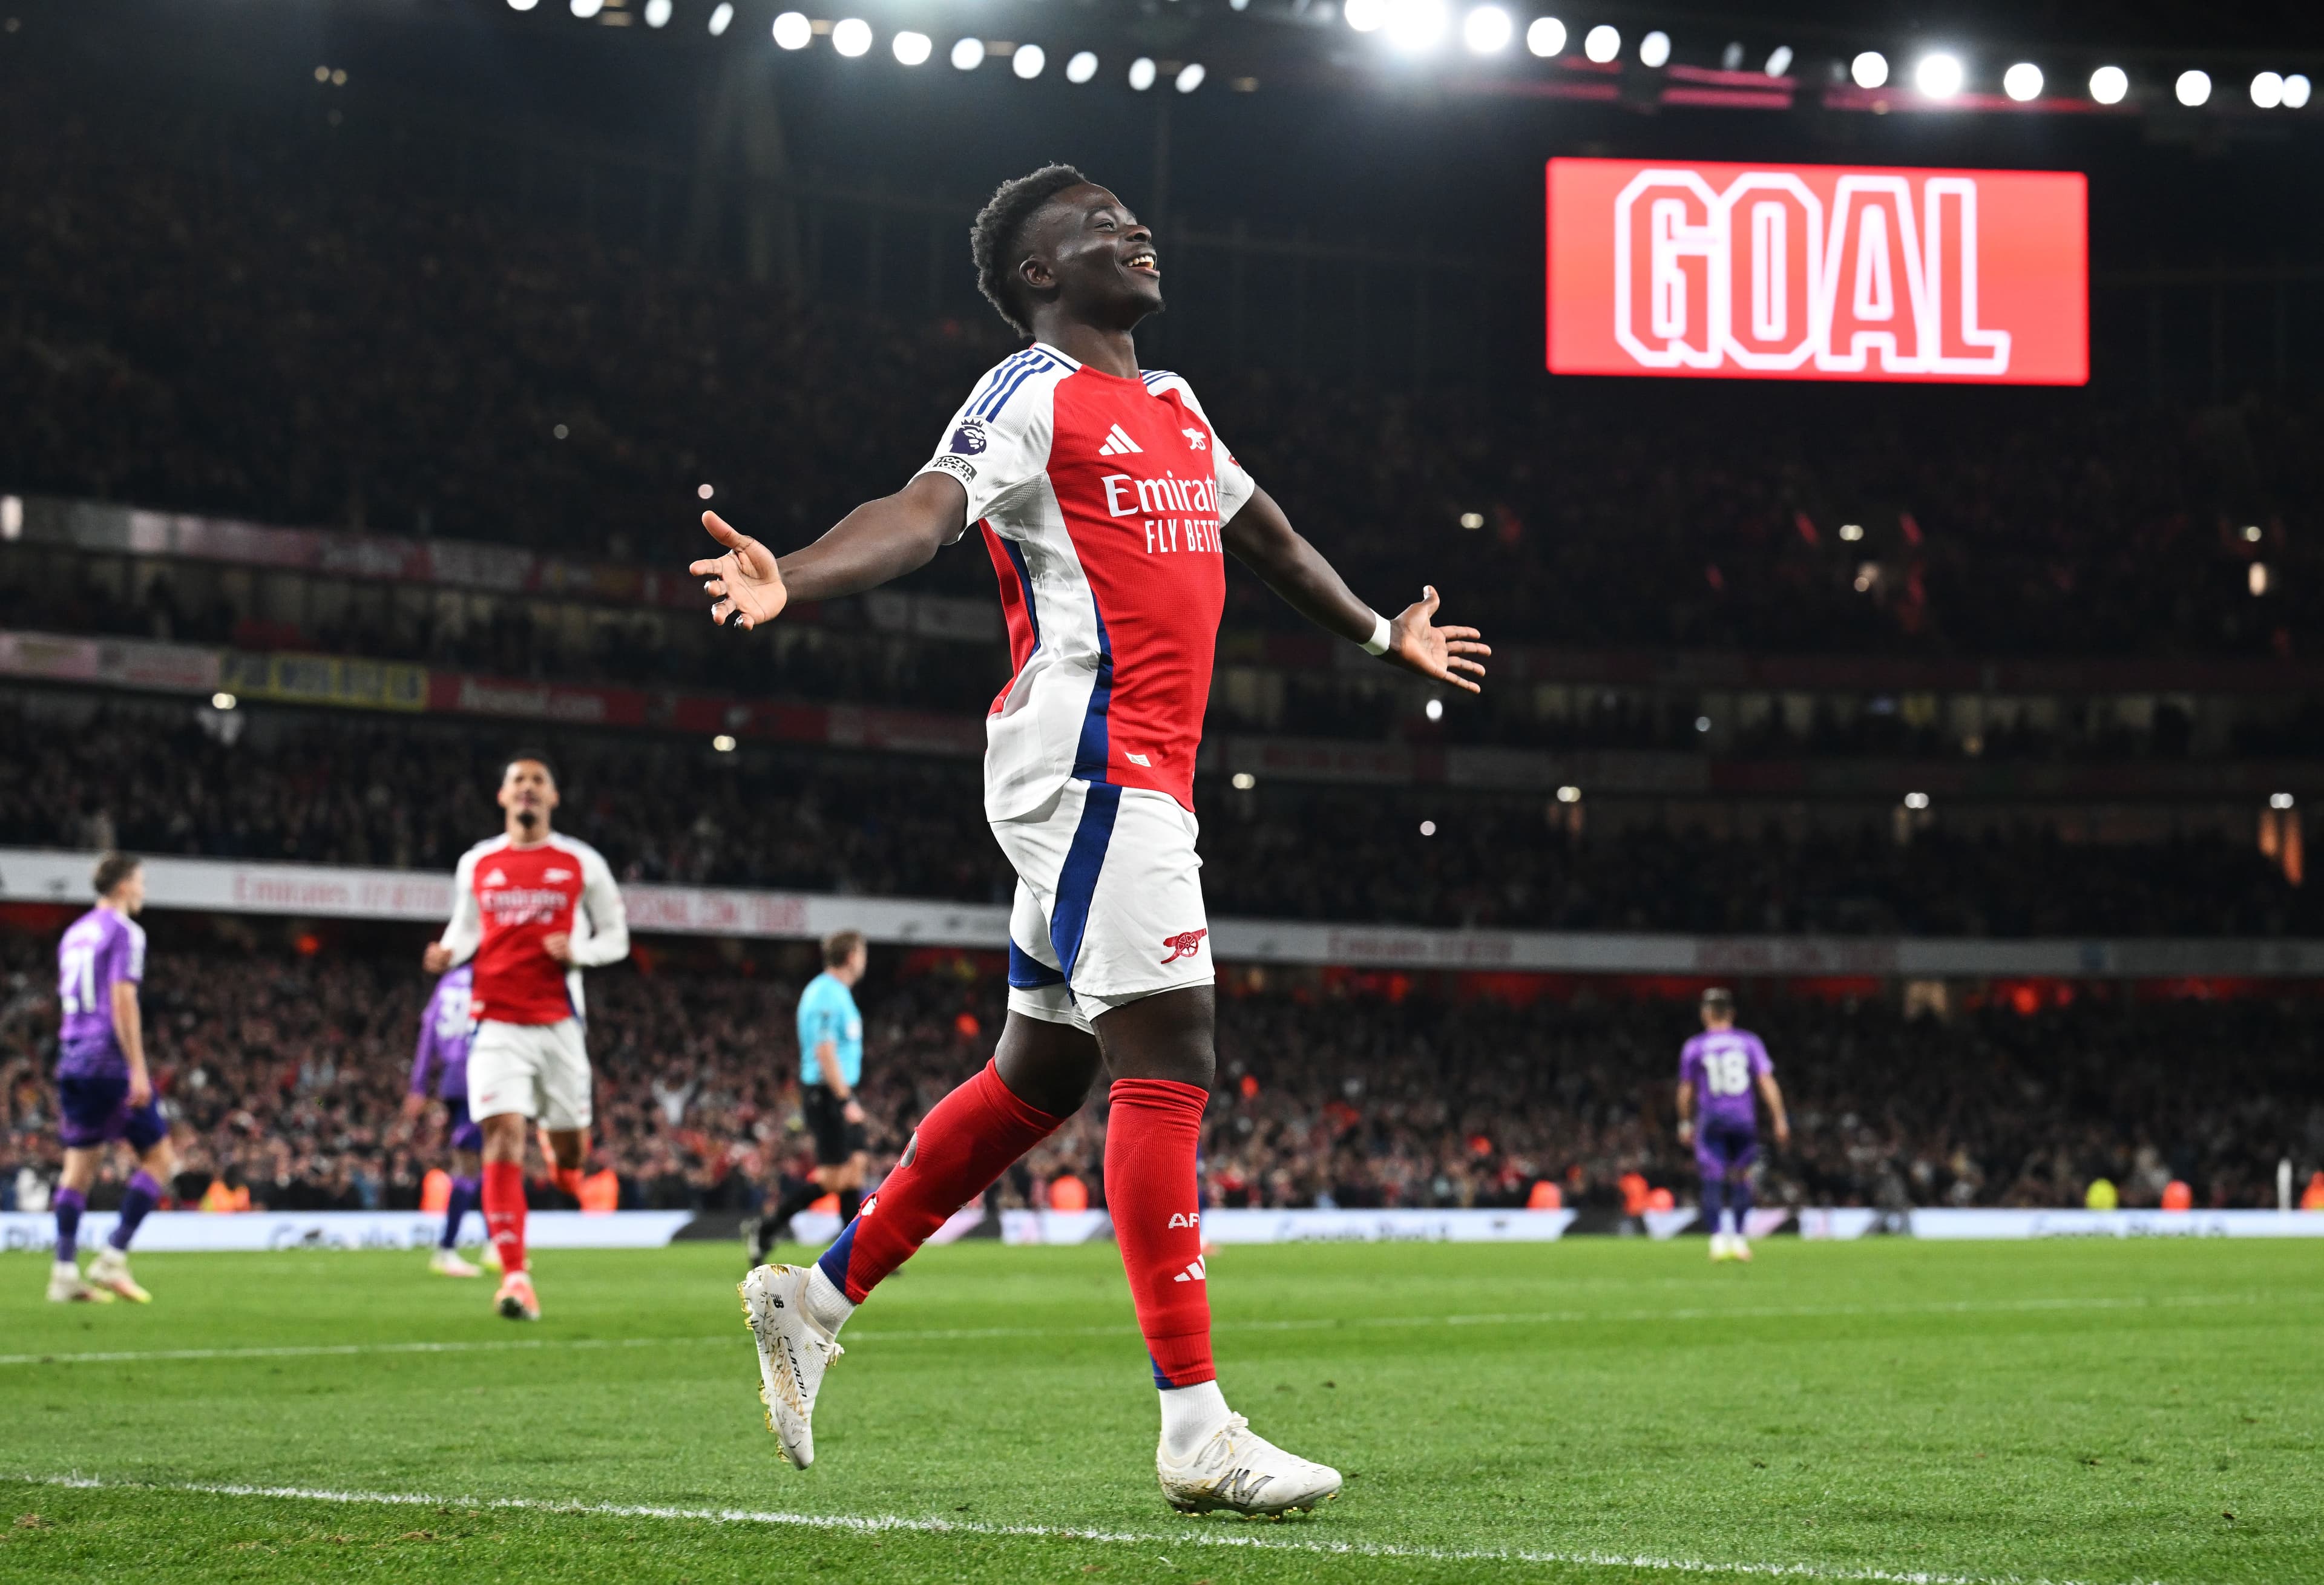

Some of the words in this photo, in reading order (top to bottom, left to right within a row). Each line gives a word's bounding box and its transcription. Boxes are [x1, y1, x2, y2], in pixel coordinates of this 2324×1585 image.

[1614, 169, 2012, 375] GOAL
[940, 456, 973, 474] room
[1100, 470, 1219, 517] Emirat
[1144, 519, 1177, 554] FLY
[1701, 1051, 1751, 1097] 18
[1168, 1212, 1201, 1229] AF
